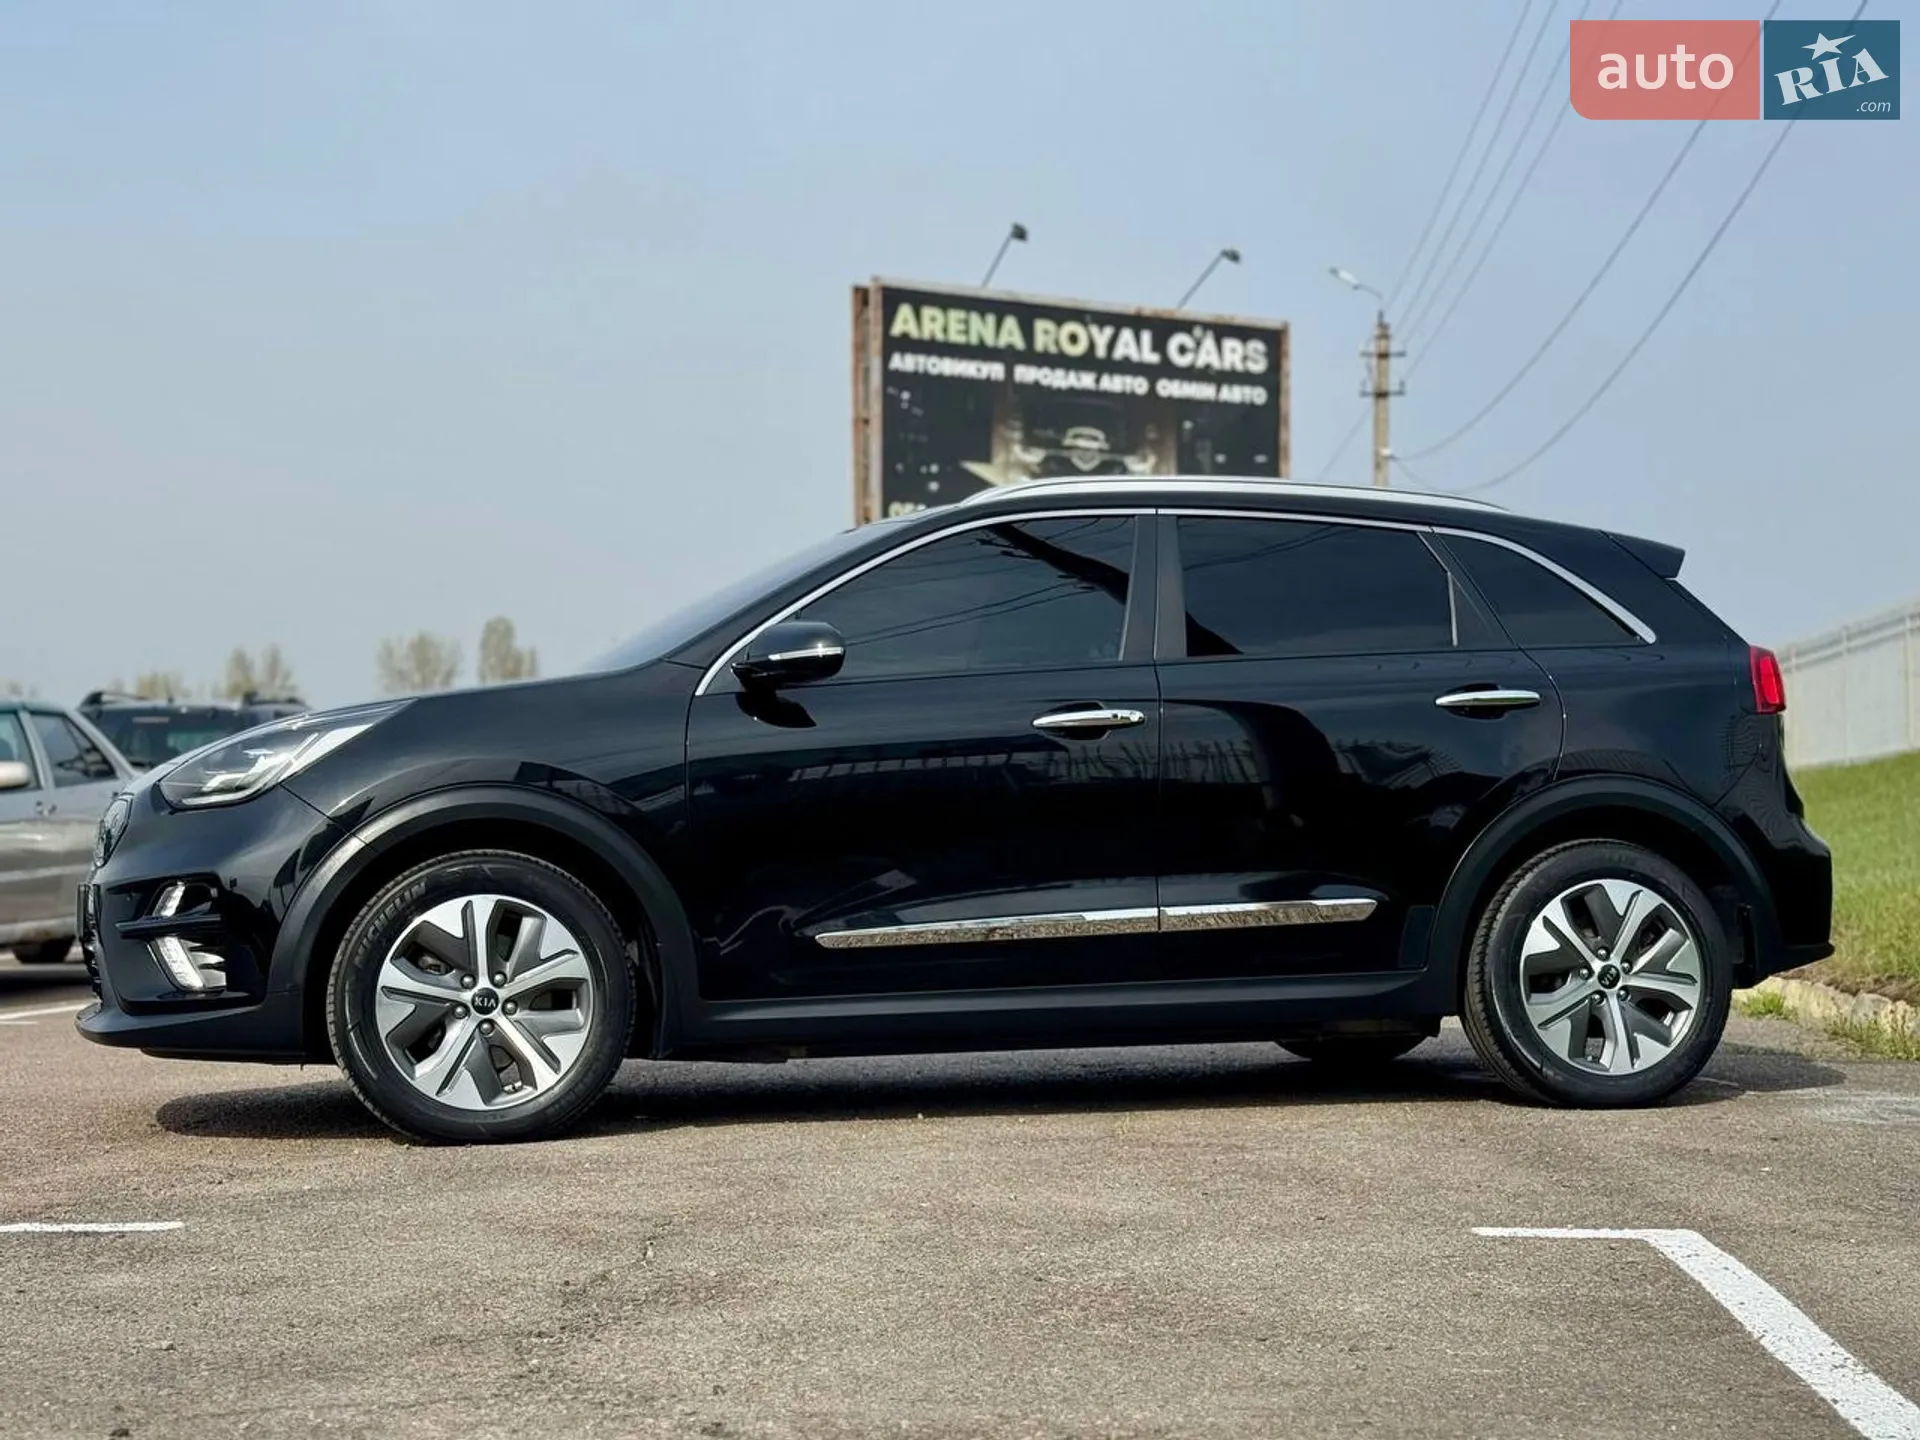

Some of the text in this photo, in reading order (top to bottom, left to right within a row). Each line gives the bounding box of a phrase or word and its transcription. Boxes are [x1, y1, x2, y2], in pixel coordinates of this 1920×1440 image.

[889, 303, 1269, 374] ARENA ROYAL CARS
[1098, 372, 1150, 396] АВТО
[1218, 384, 1269, 406] АВТО
[353, 876, 427, 969] MICHELIN
[474, 996, 496, 1008] KIA
